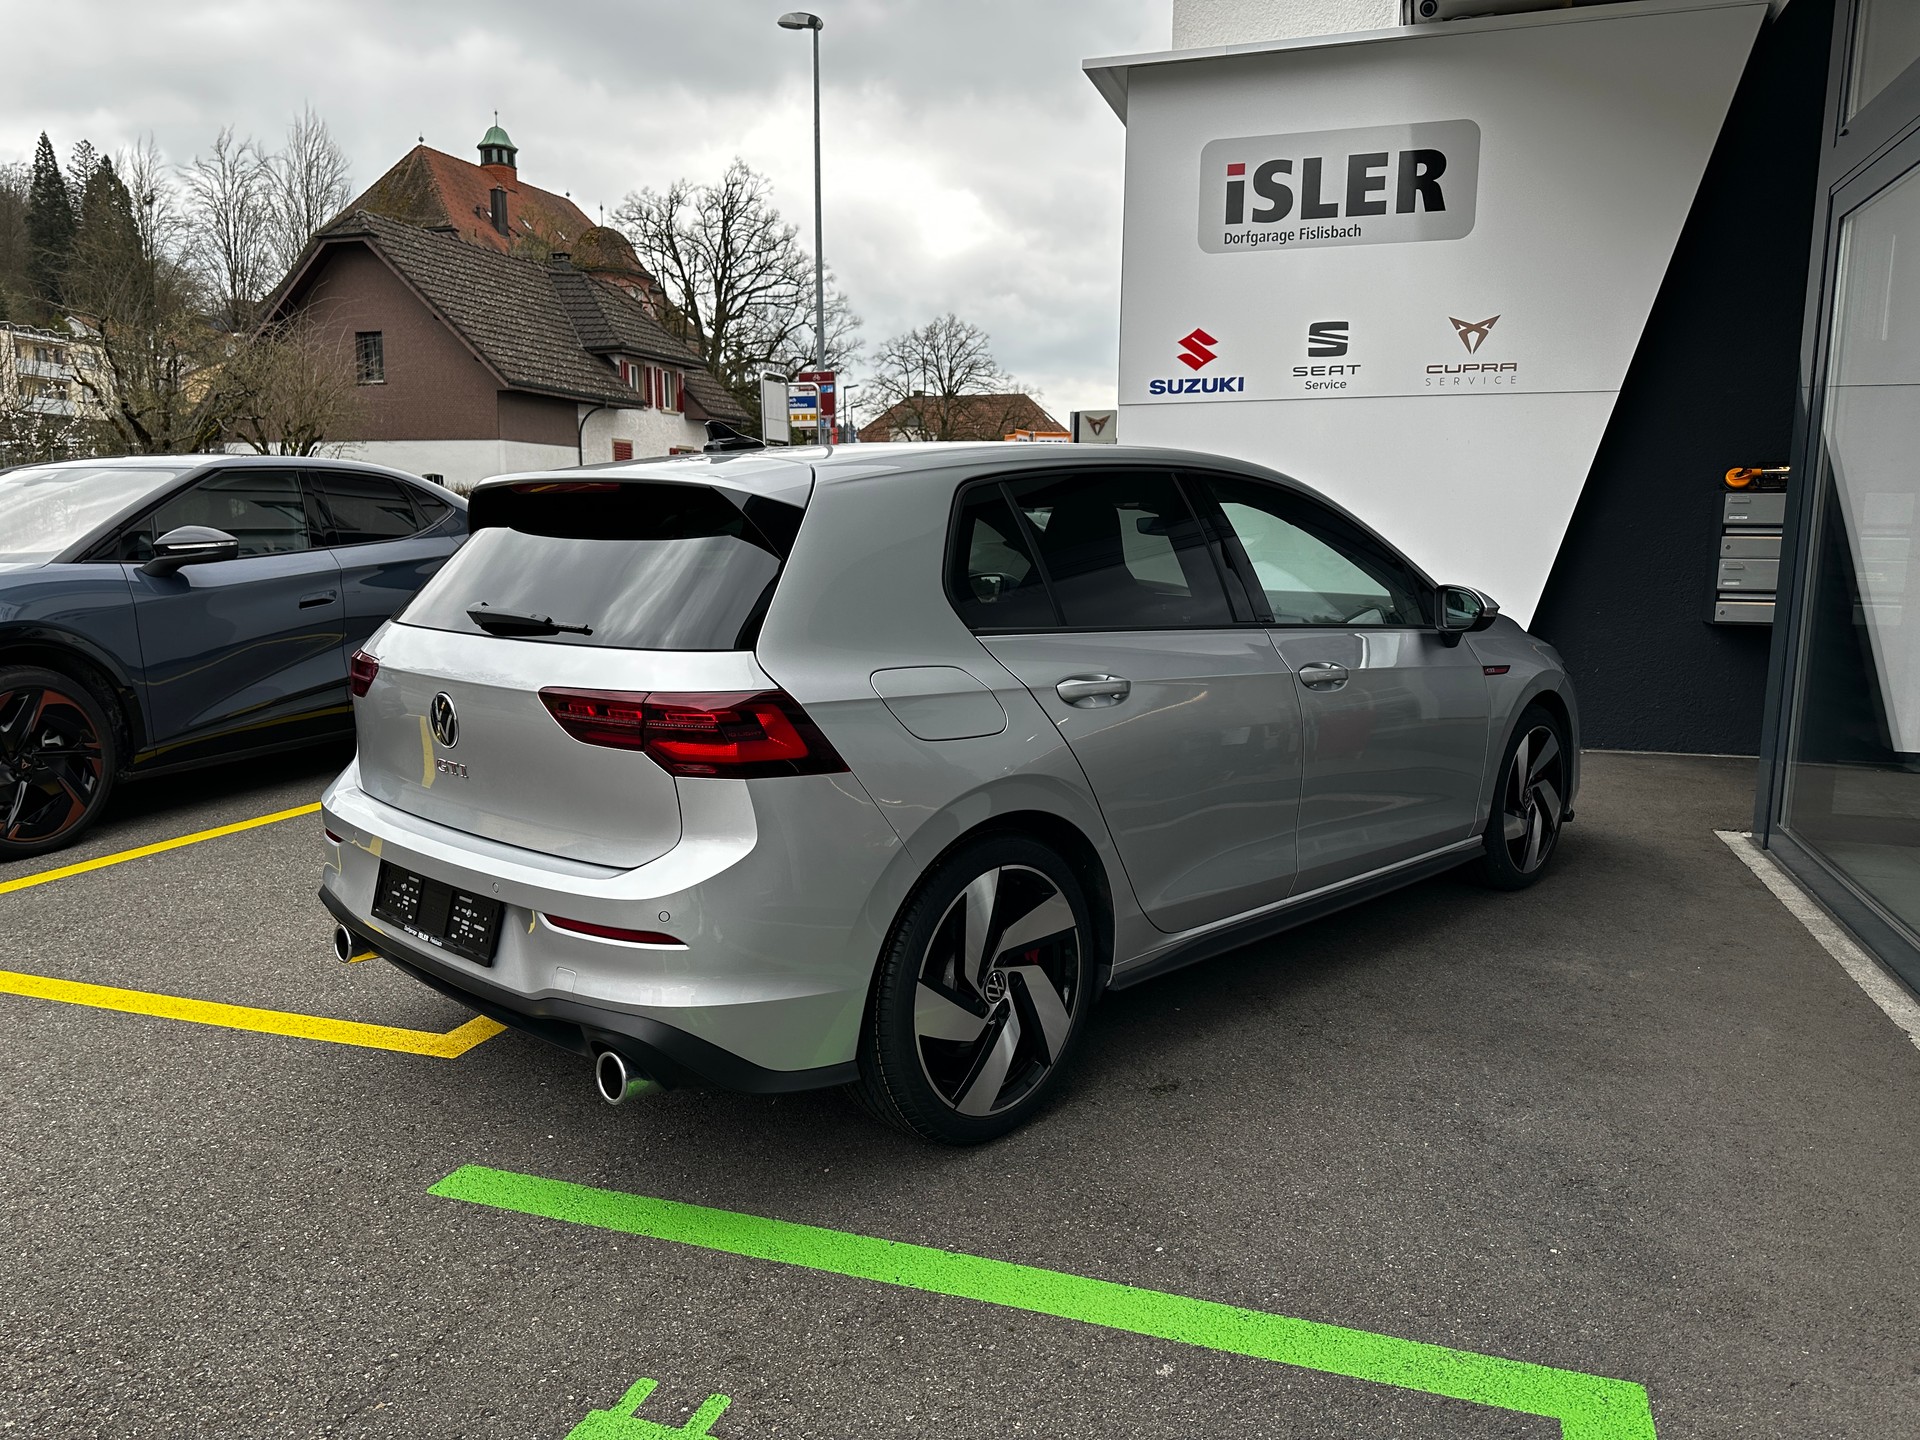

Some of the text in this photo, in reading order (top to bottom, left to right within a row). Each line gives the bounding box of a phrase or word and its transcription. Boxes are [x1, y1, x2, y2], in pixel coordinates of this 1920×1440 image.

[1224, 224, 1362, 247] Dorfgarage Fislisbach
[1292, 364, 1362, 377] SEAT
[1426, 362, 1518, 374] CUPRA
[1149, 376, 1245, 396] SUZUKI
[1304, 379, 1347, 390] Service
[1425, 375, 1517, 387] SERVICE
[437, 758, 469, 779] GTI
